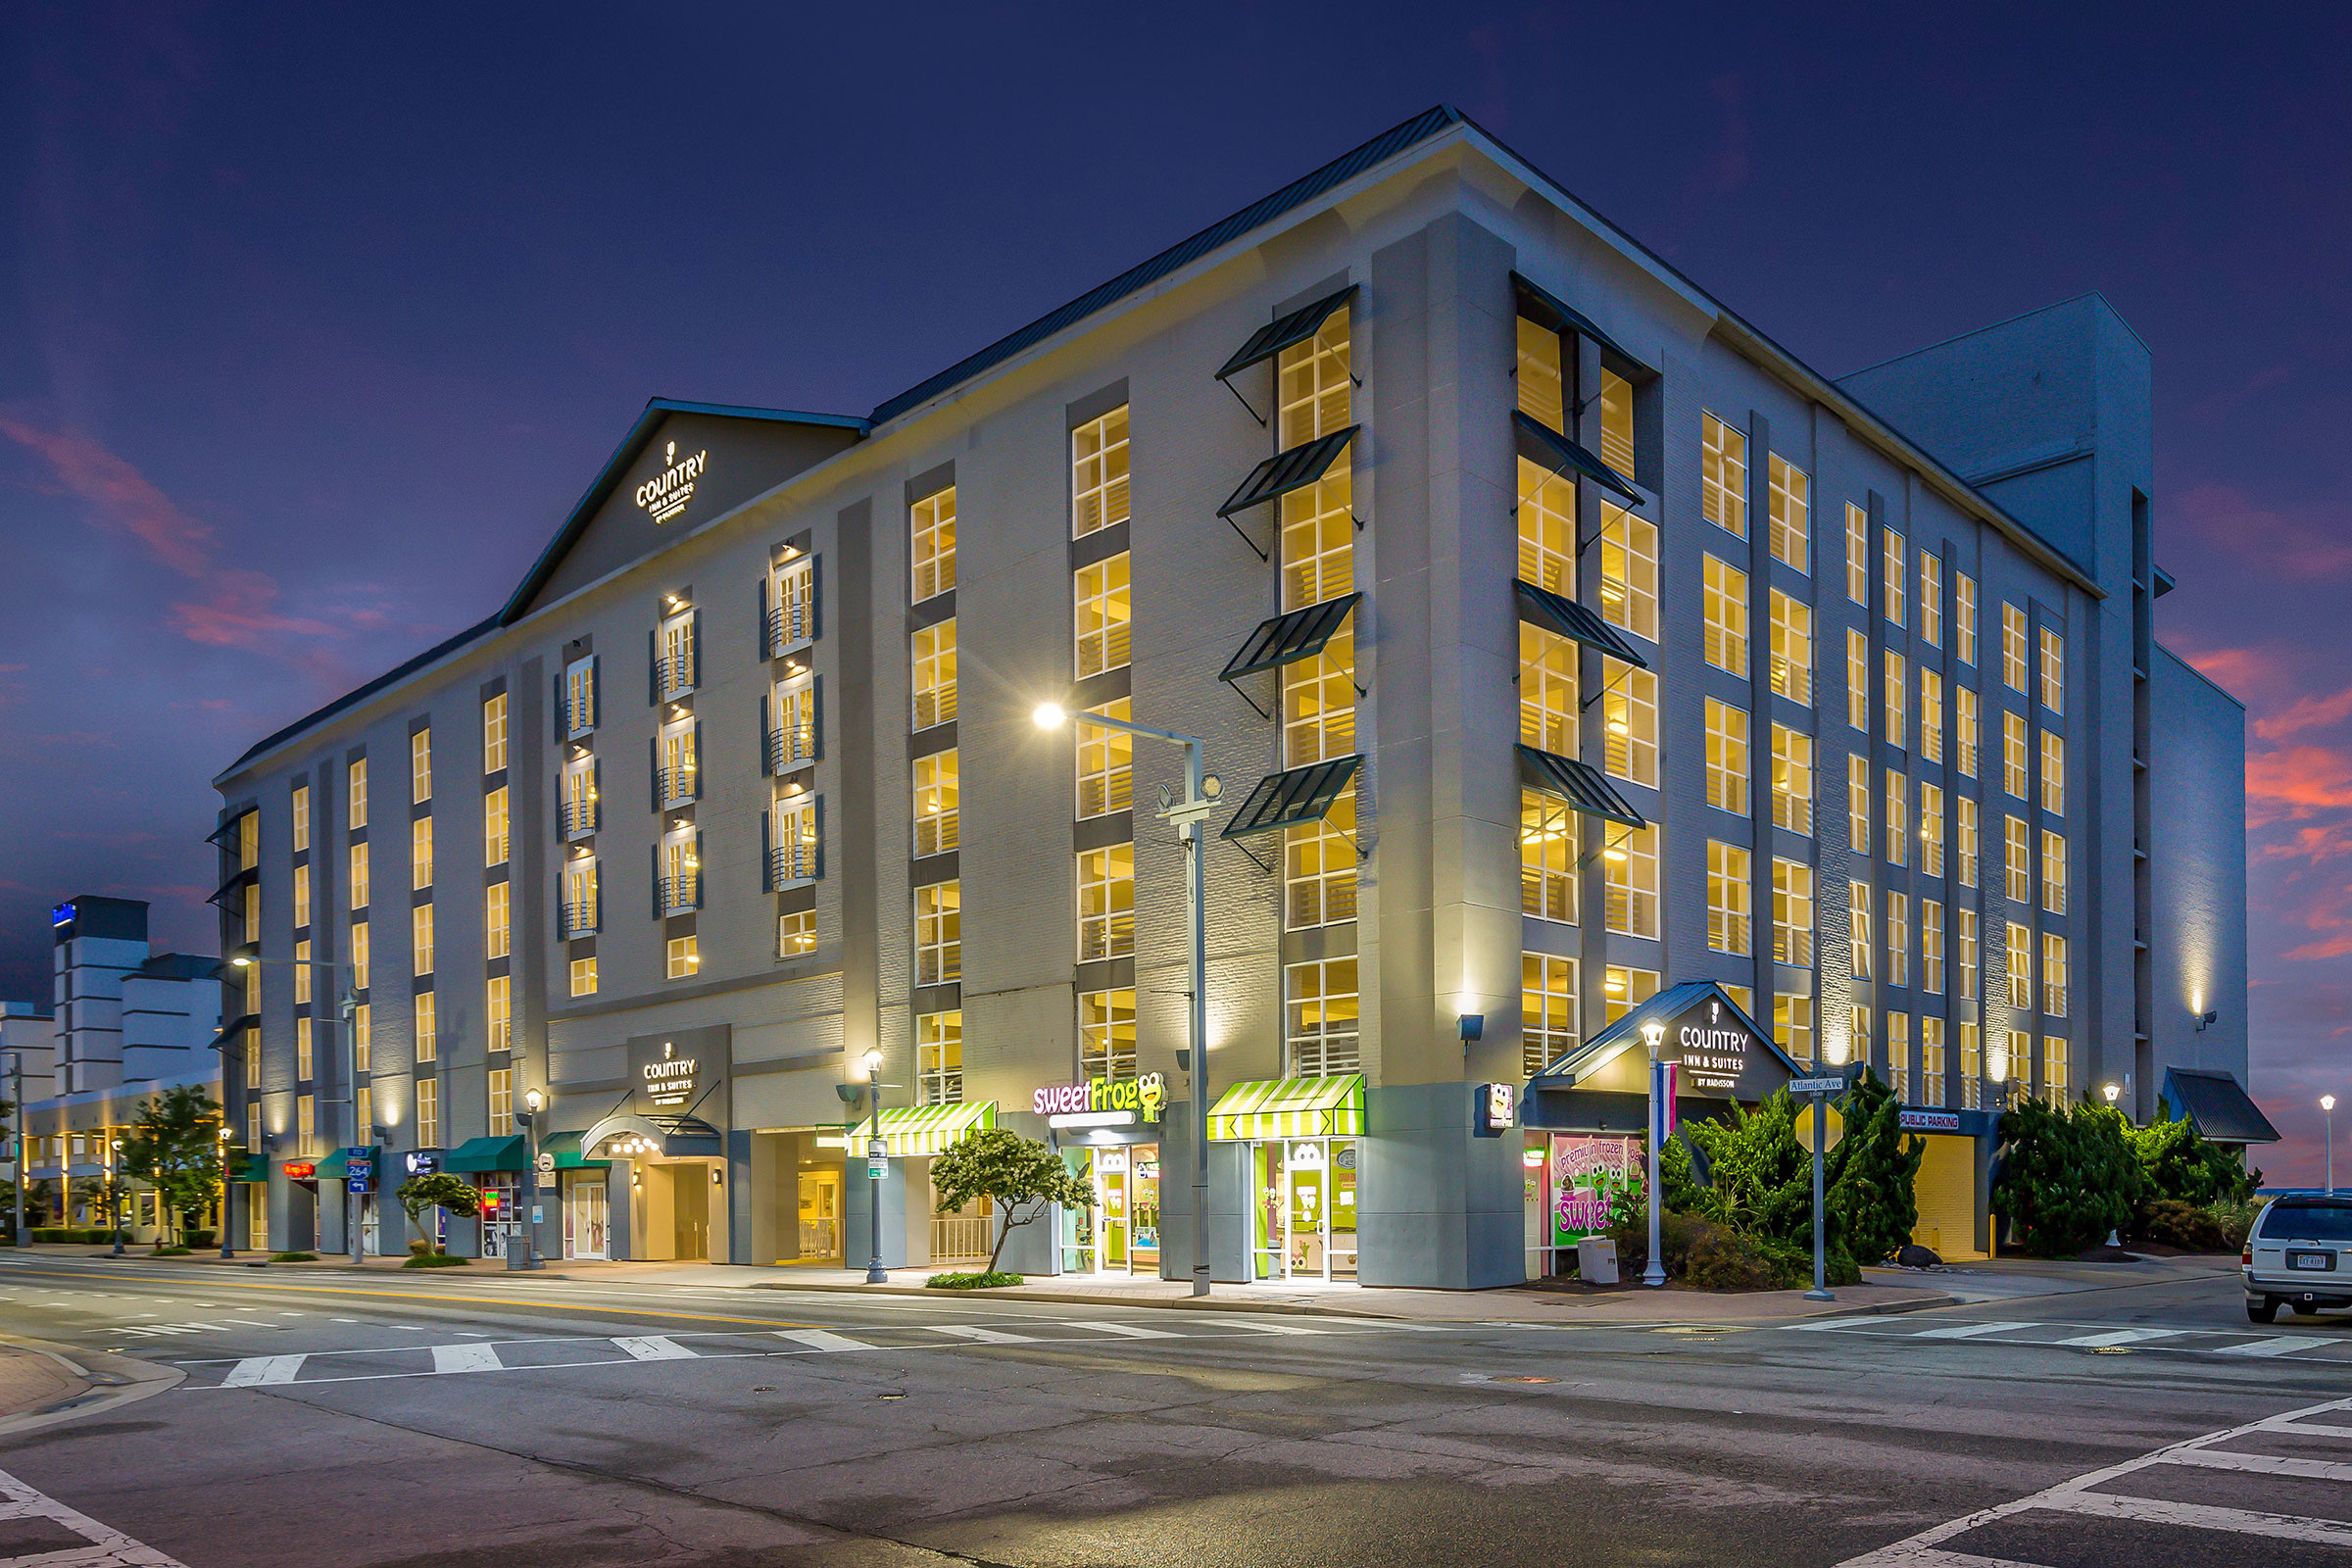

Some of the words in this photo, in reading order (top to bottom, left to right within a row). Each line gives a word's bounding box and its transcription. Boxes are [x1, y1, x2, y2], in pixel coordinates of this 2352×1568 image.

[668, 482, 694, 502] SUITES
[1684, 1054, 1701, 1067] INN
[1702, 1055, 1710, 1068] &
[1711, 1056, 1743, 1071] SUITES
[666, 1079, 692, 1091] SUITES
[1697, 1078, 1706, 1087] BY
[1706, 1078, 1735, 1089] RADISSON
[1790, 1080, 1823, 1091] Atlantic
[1824, 1079, 1841, 1089] Ave
[1900, 1113, 1927, 1126] PUBLIC
[1927, 1115, 1958, 1128] PARKING
[1598, 1140, 1624, 1156] frozen
[349, 1165, 368, 1177] 264
